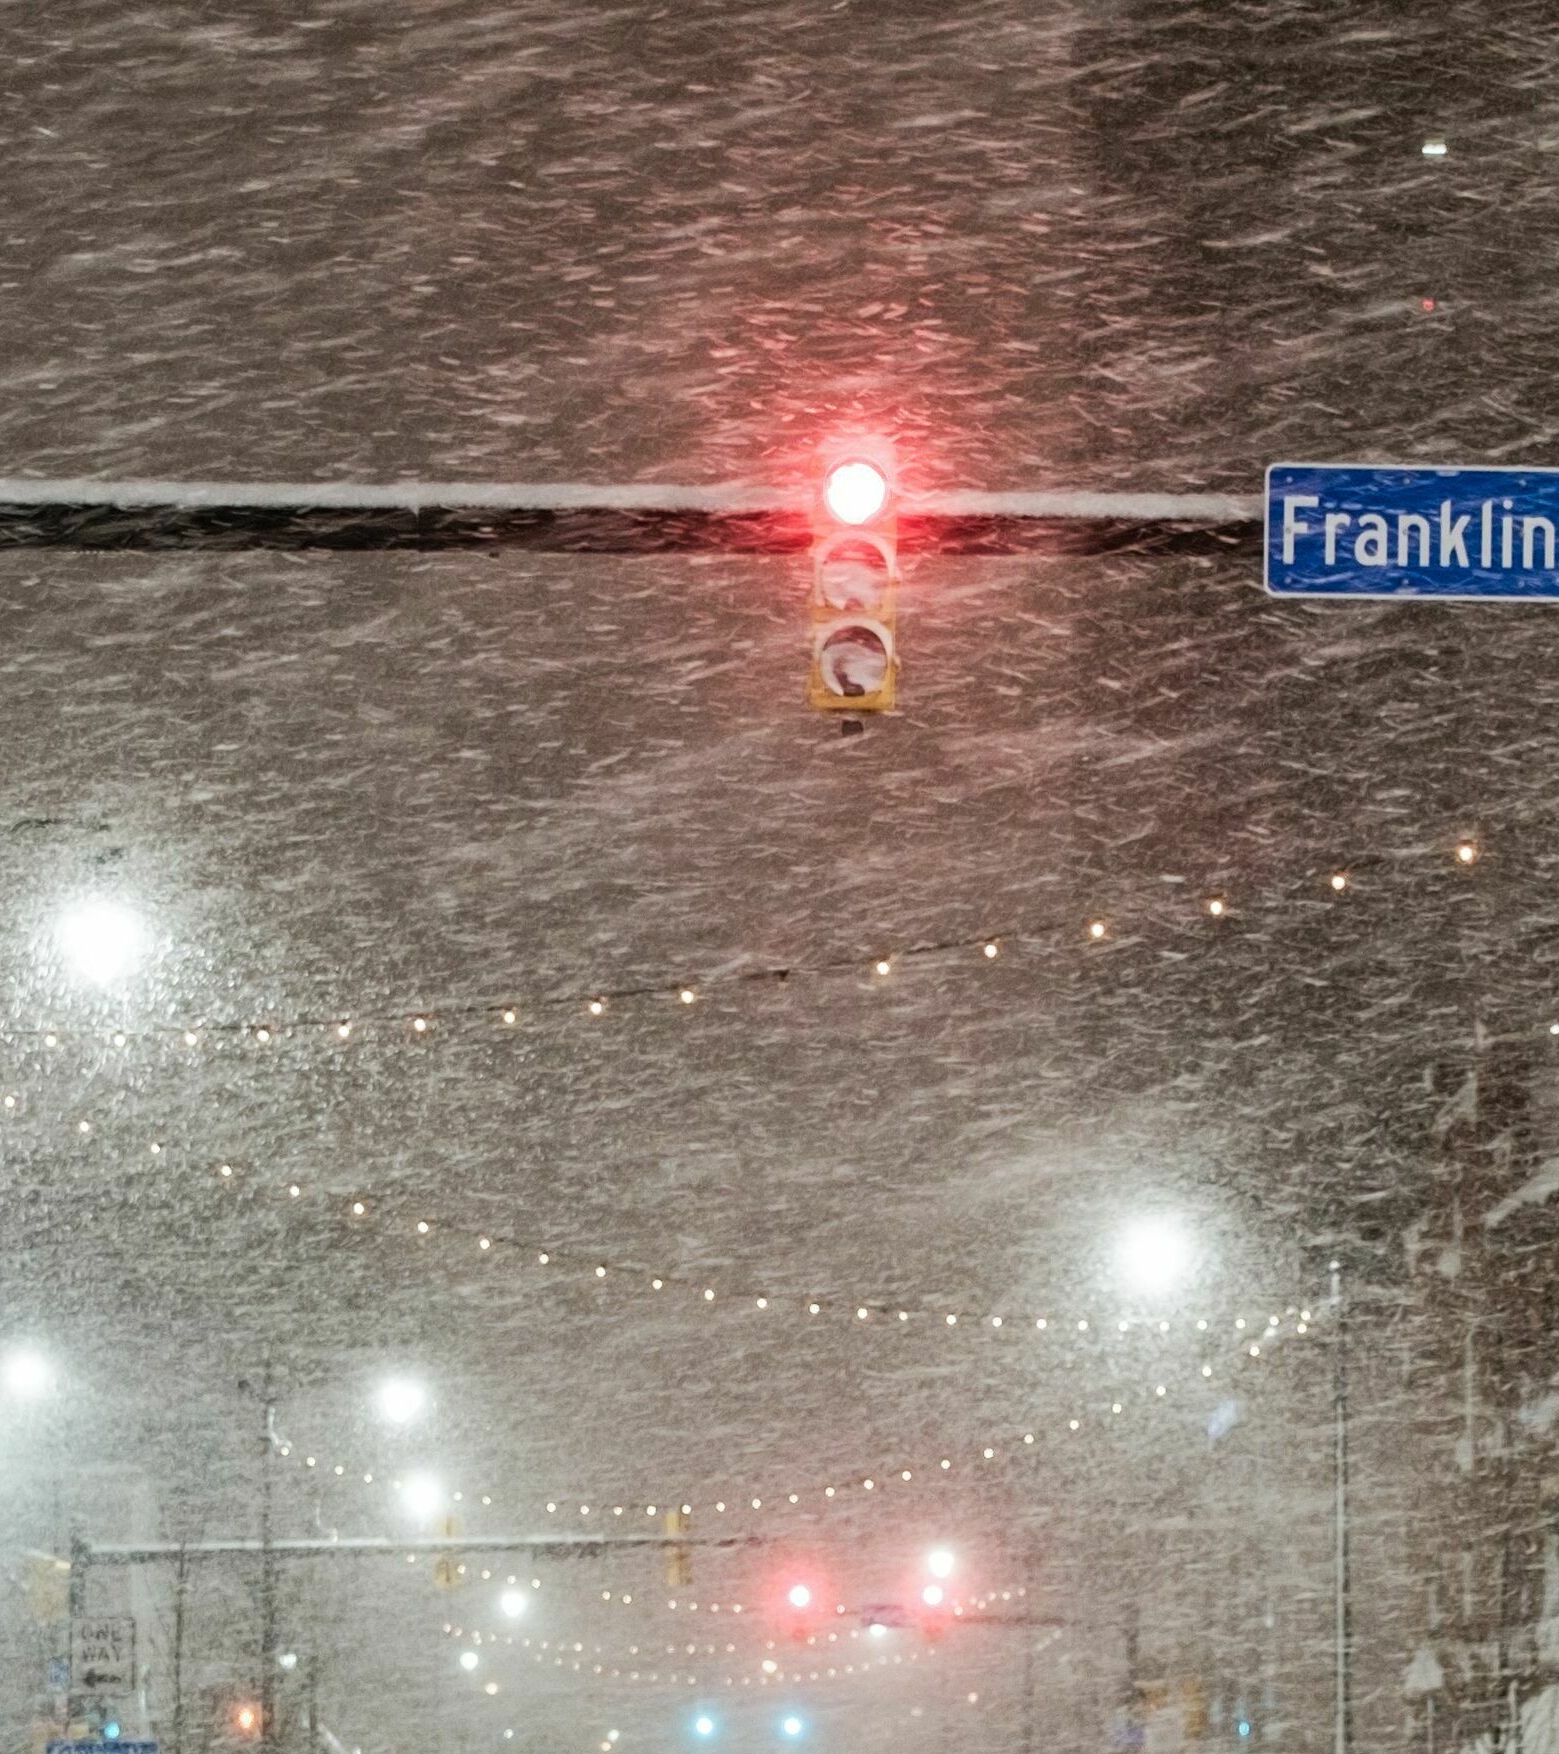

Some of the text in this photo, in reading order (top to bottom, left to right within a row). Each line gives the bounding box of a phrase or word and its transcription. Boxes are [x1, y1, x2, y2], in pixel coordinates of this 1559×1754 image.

[1282, 495, 1556, 570] Franklin
[81, 1624, 122, 1642] ONE
[81, 1645, 122, 1662] WAY
